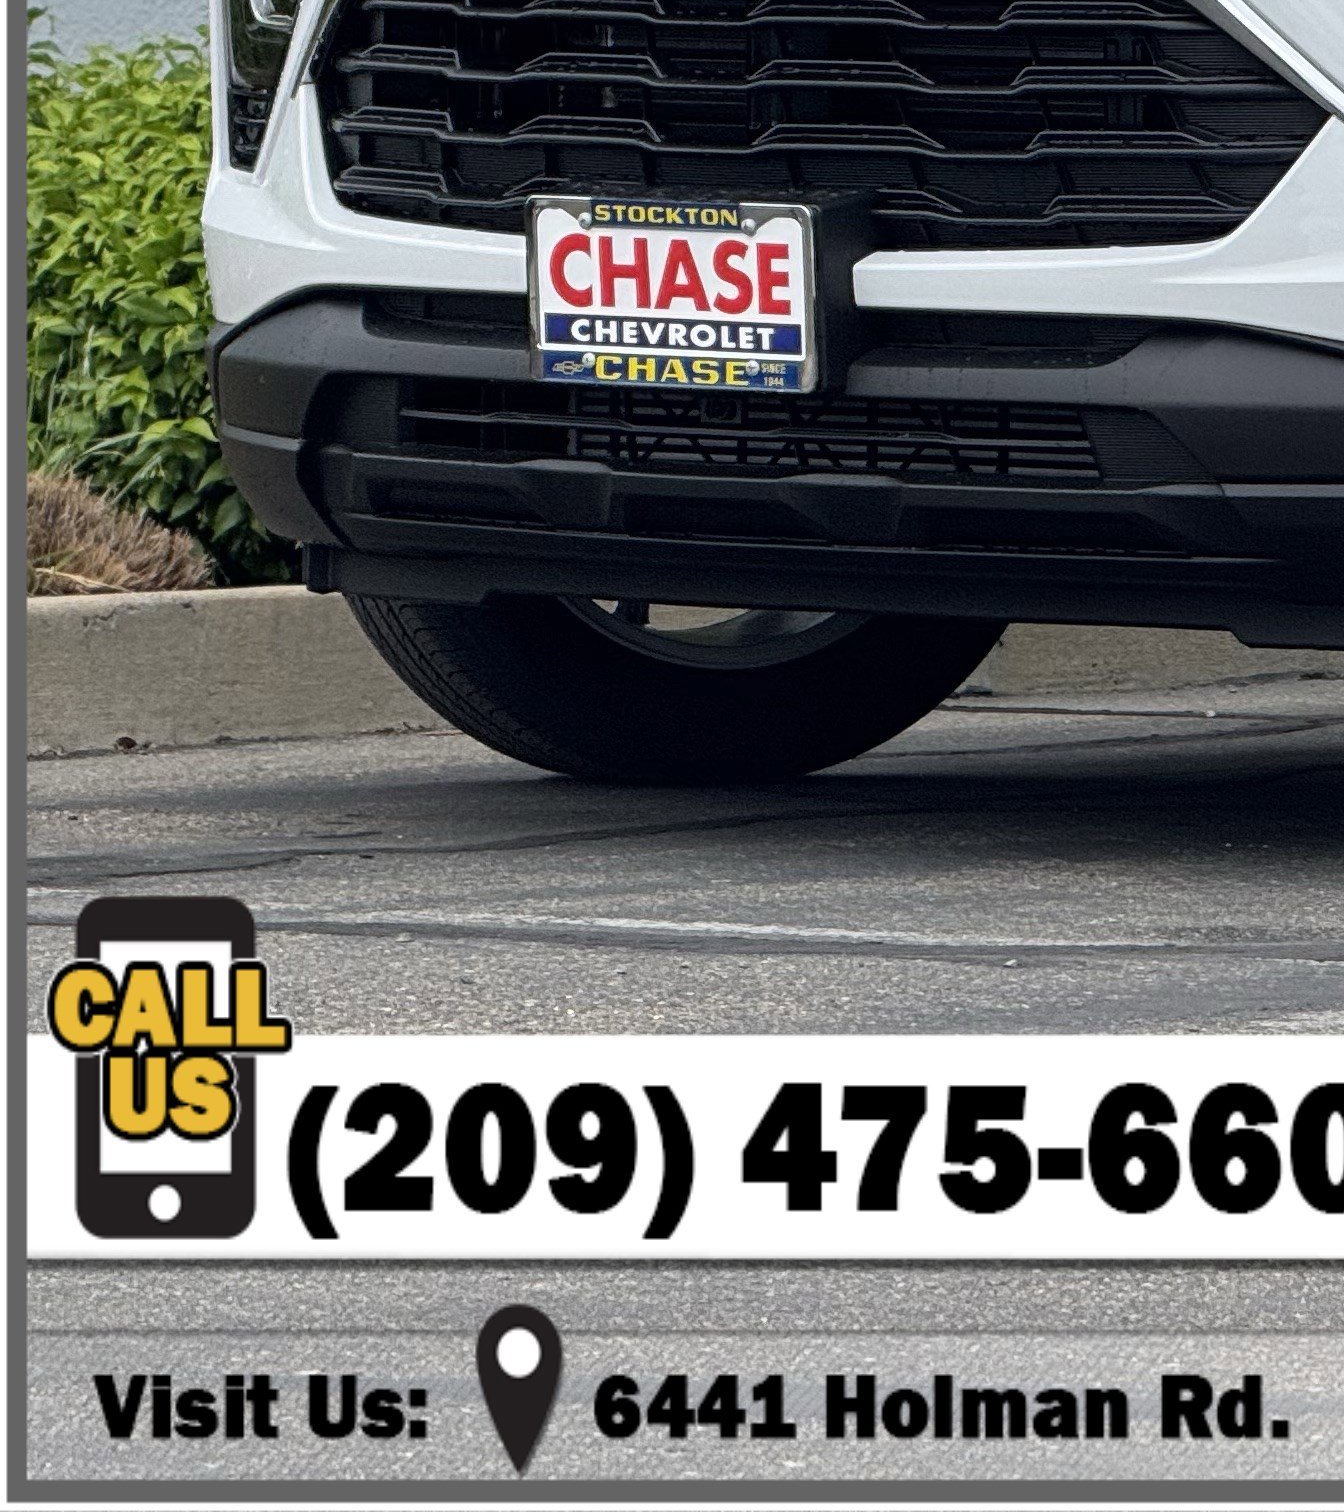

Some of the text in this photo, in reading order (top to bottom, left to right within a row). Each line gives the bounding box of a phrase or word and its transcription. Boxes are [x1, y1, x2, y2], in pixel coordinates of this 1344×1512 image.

[594, 204, 738, 227] STOCKTON
[549, 233, 792, 316] CHASE
[570, 318, 775, 351] CHEVROLET
[594, 355, 750, 387] CHASE
